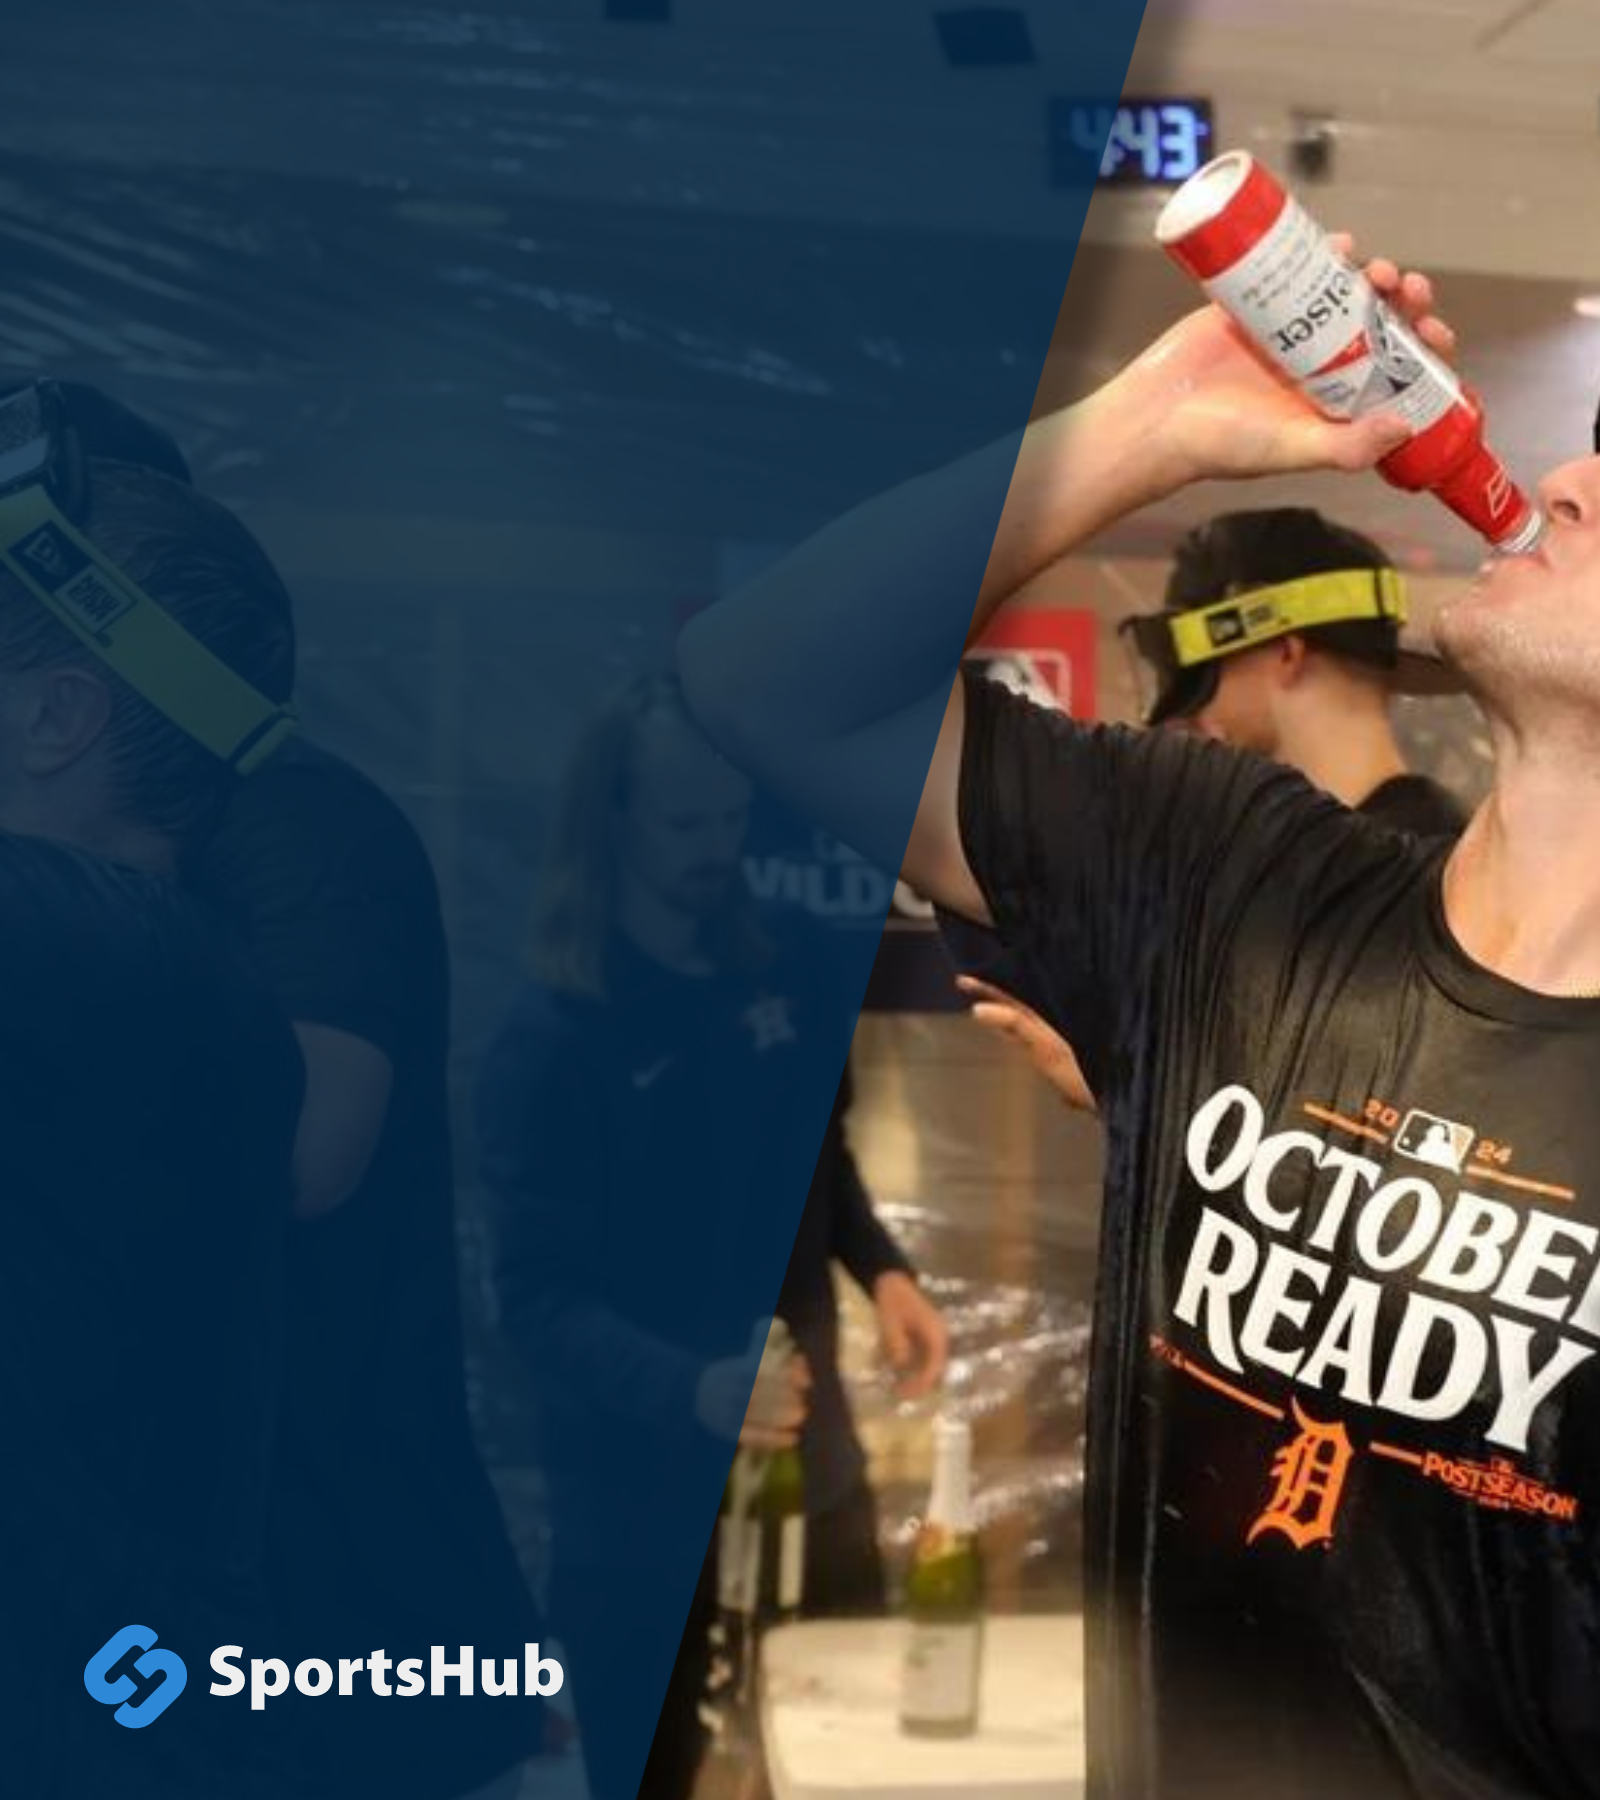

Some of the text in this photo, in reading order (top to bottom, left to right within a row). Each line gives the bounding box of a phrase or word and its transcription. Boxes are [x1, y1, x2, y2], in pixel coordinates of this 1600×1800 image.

[1365, 1098, 1400, 1128] 20
[1174, 1206, 1597, 1454] READY
[1423, 1451, 1578, 1521] POSTSEASON
